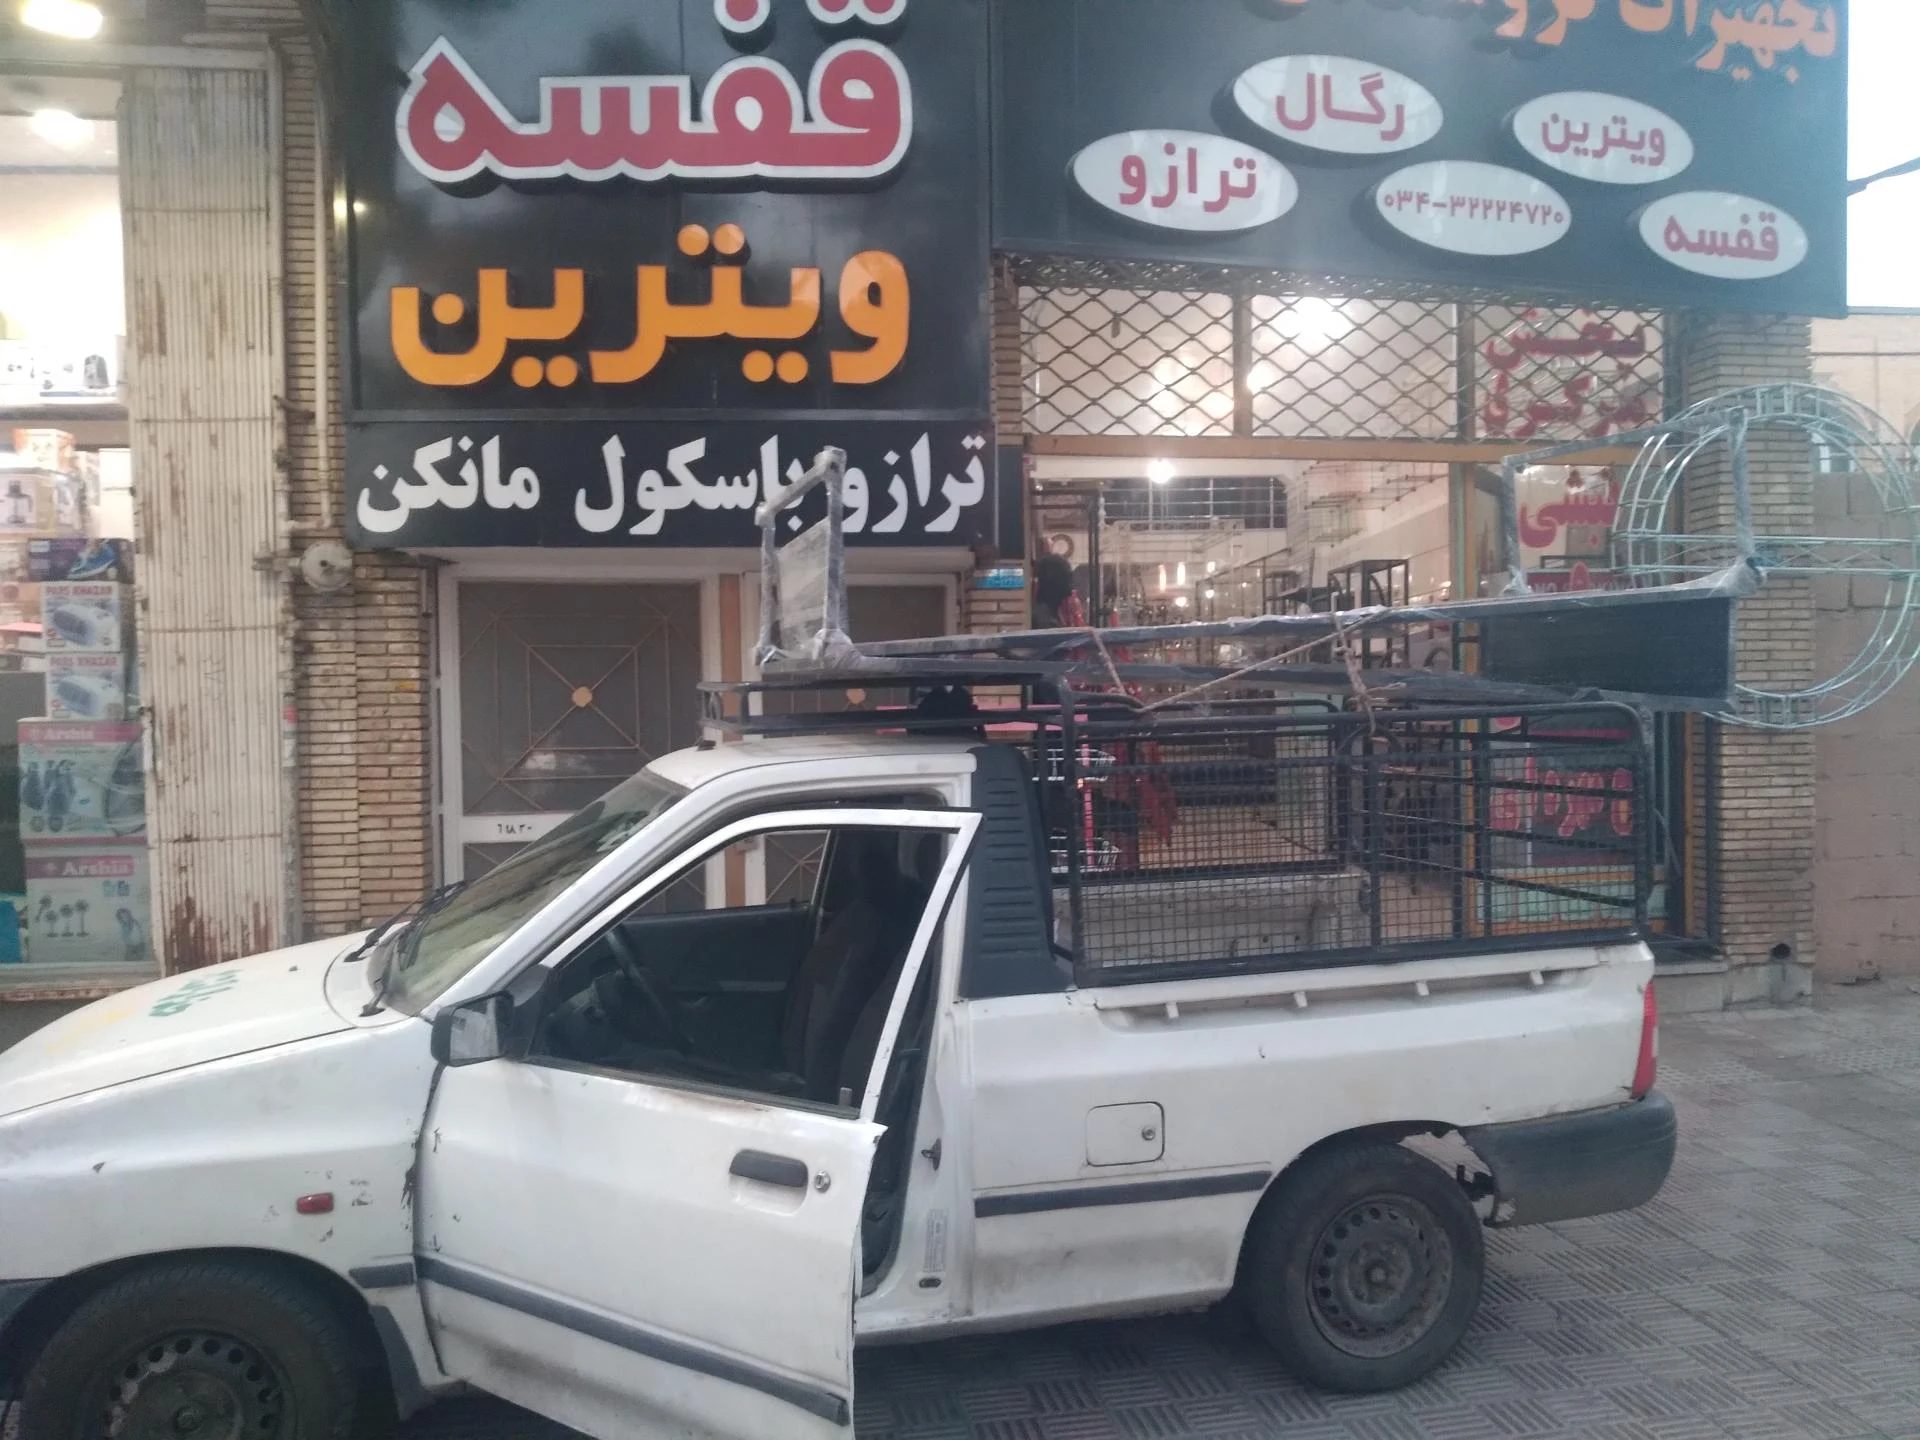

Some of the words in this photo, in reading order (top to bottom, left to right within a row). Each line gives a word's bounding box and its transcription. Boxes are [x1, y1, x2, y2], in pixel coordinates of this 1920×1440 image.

[396, 0, 913, 182] قفسه
[1274, 71, 1407, 141] رگال
[1540, 111, 1666, 167] ویترین
[1117, 143, 1258, 212] ترازو
[1662, 211, 1781, 263] قفسه
[390, 223, 911, 388] ویترین
[356, 434, 541, 533] مانکن
[575, 434, 805, 535] باسکول
[841, 431, 986, 533] ترازو
